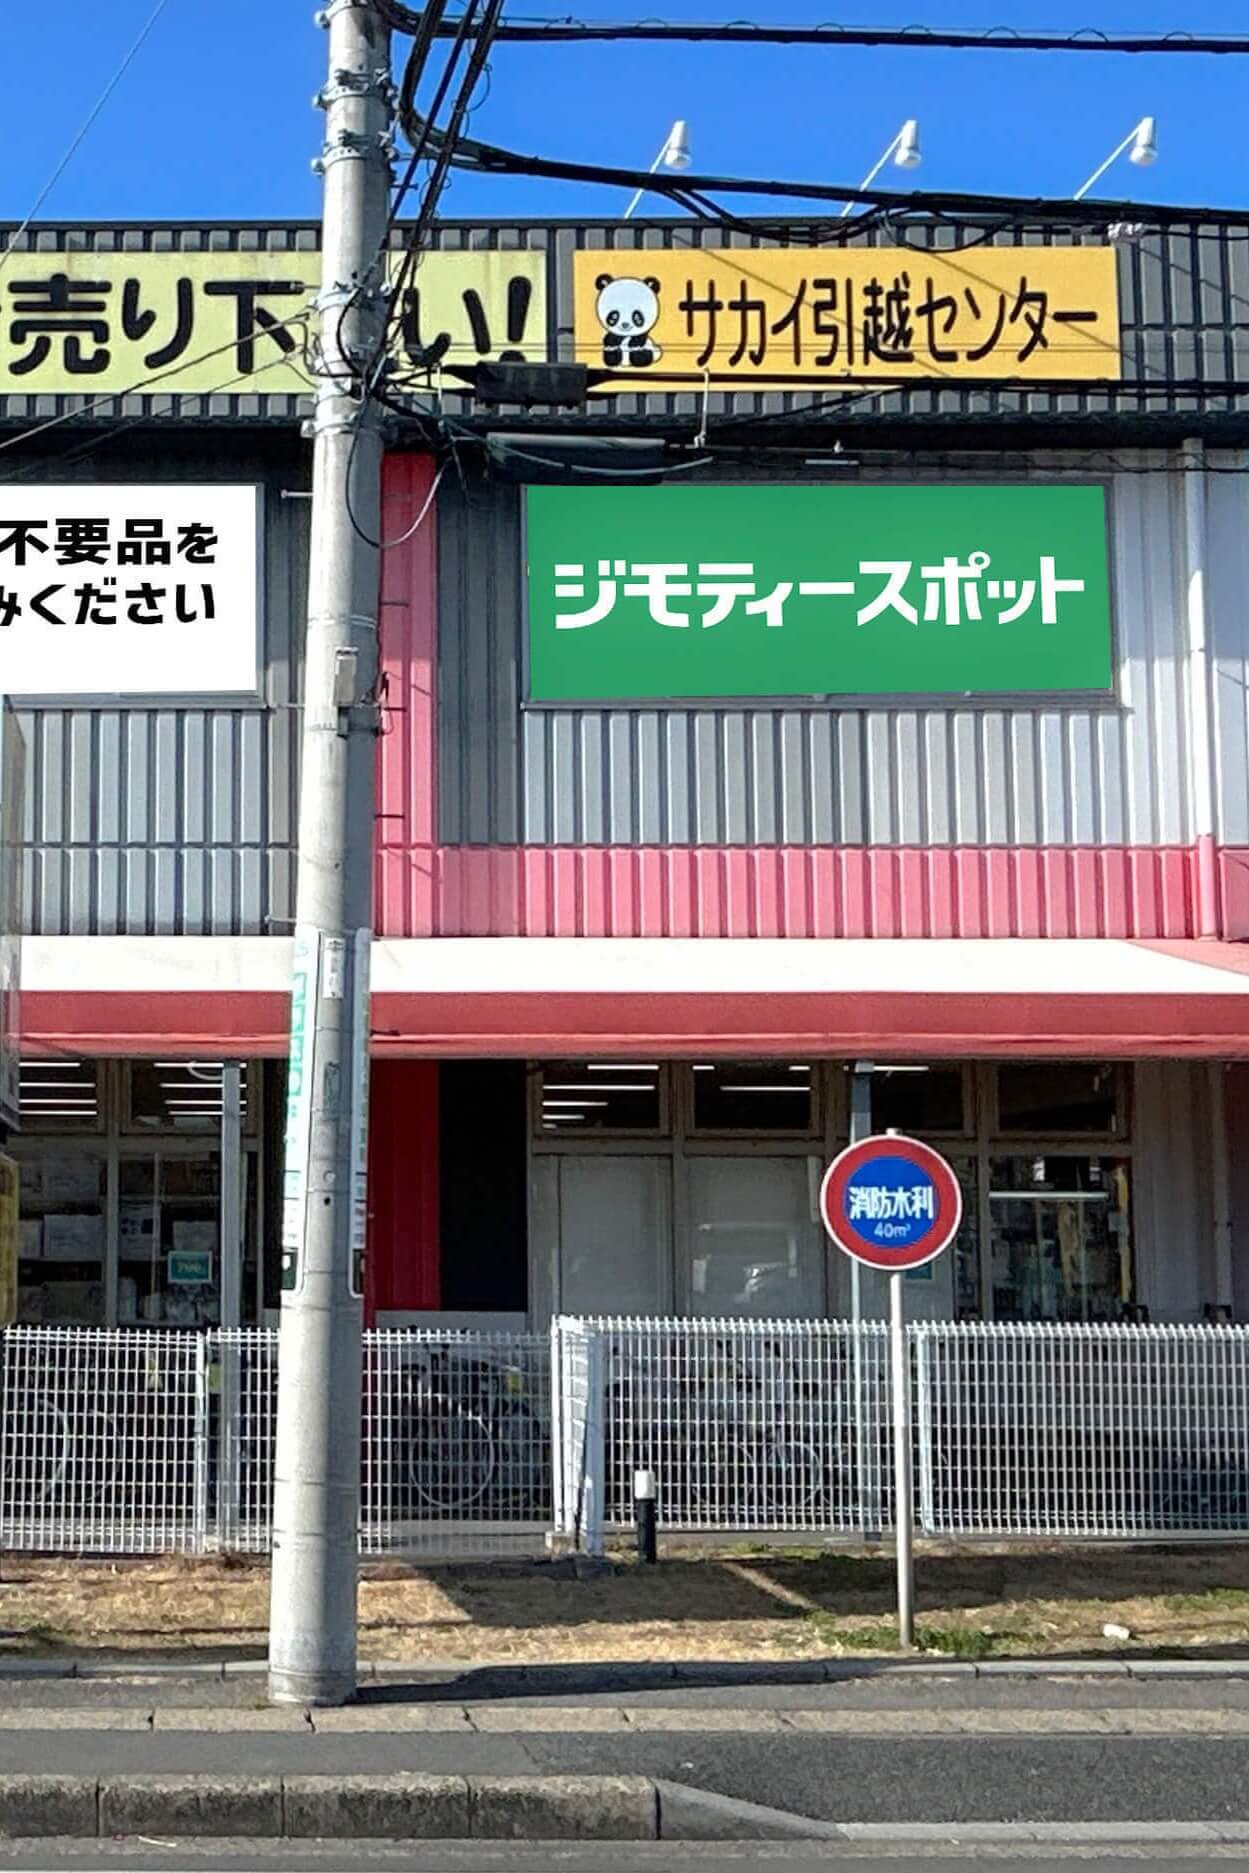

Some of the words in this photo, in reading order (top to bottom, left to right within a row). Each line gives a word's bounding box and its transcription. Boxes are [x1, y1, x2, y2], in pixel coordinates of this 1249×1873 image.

[679, 271, 1098, 366] サカイ引越センター
[554, 551, 1085, 629] ジモティースポット
[848, 1185, 934, 1220] 消防水利
